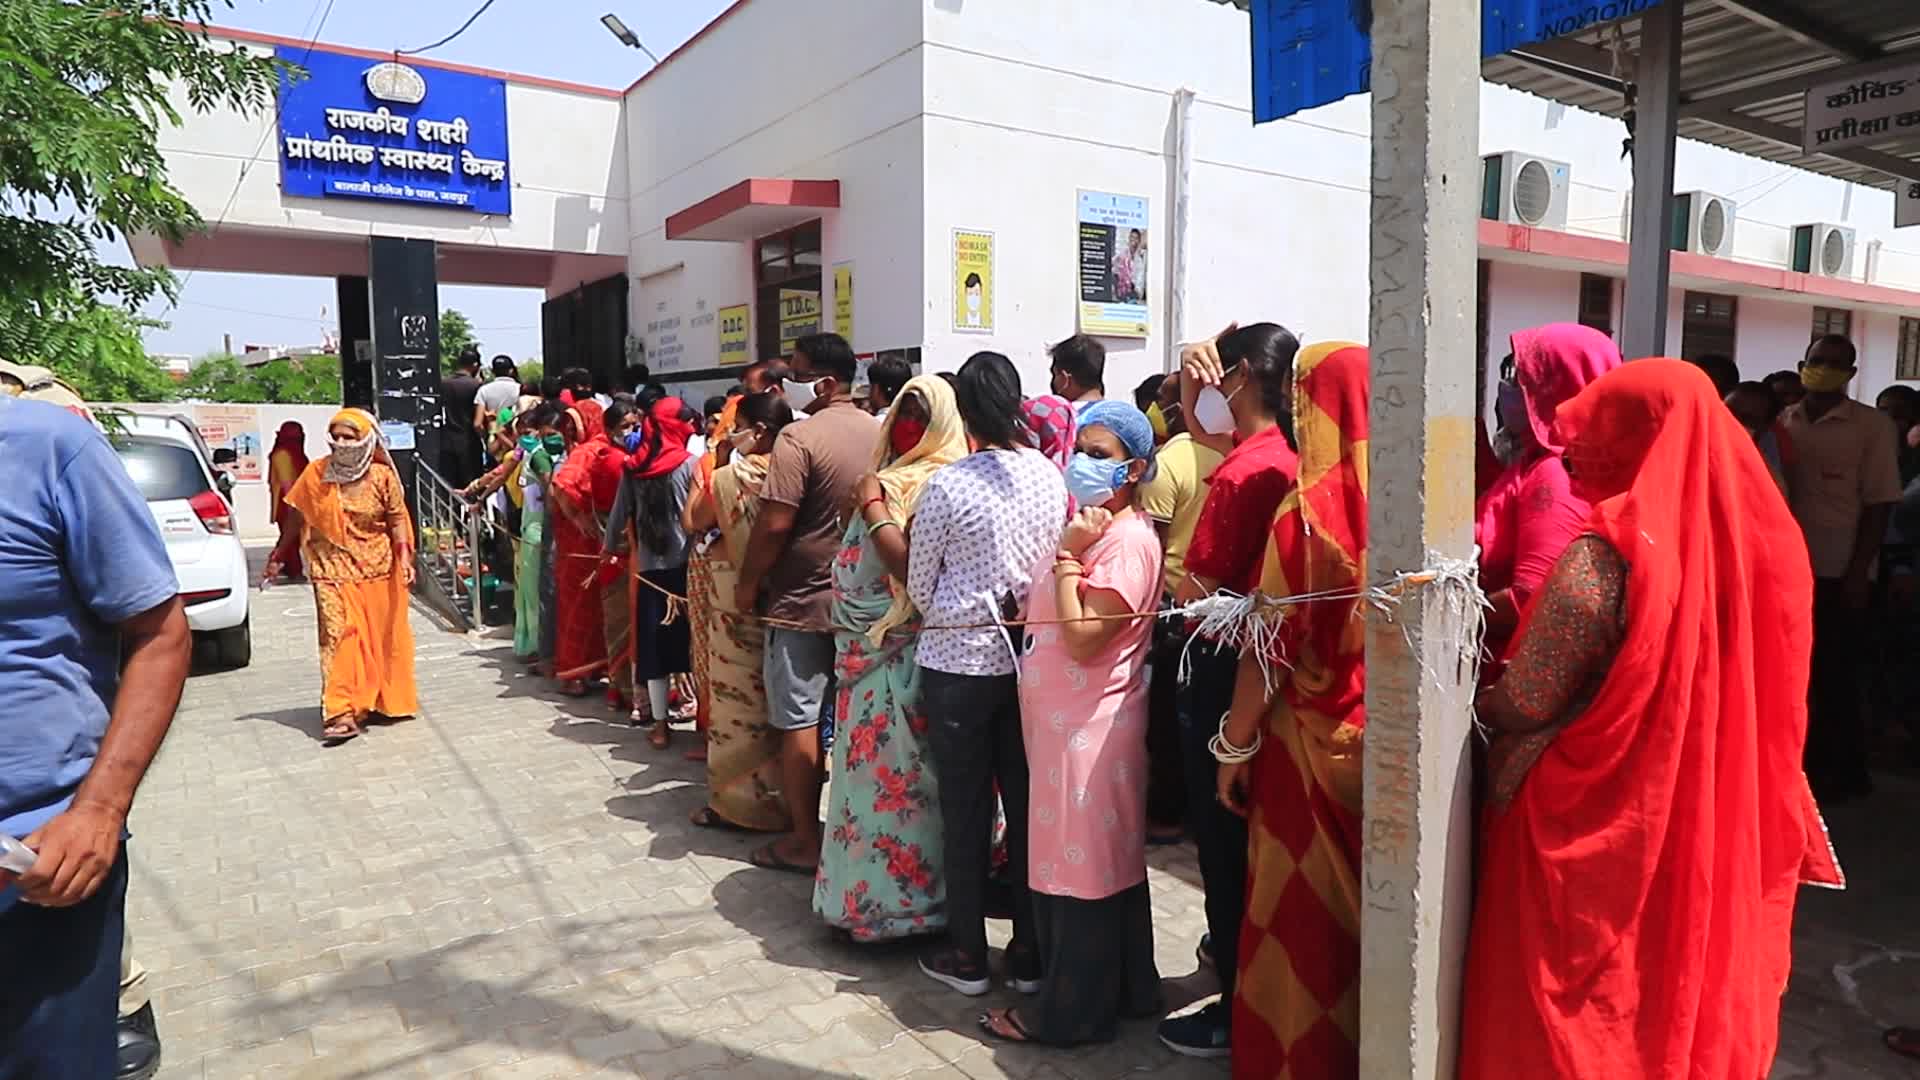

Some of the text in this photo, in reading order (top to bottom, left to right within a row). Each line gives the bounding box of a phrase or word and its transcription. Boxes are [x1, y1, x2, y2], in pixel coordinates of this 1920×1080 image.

[325, 106, 469, 145] राजकीय शहरी
[285, 134, 505, 182] प्राथमिक स्वास्थ्य केन्द्र
